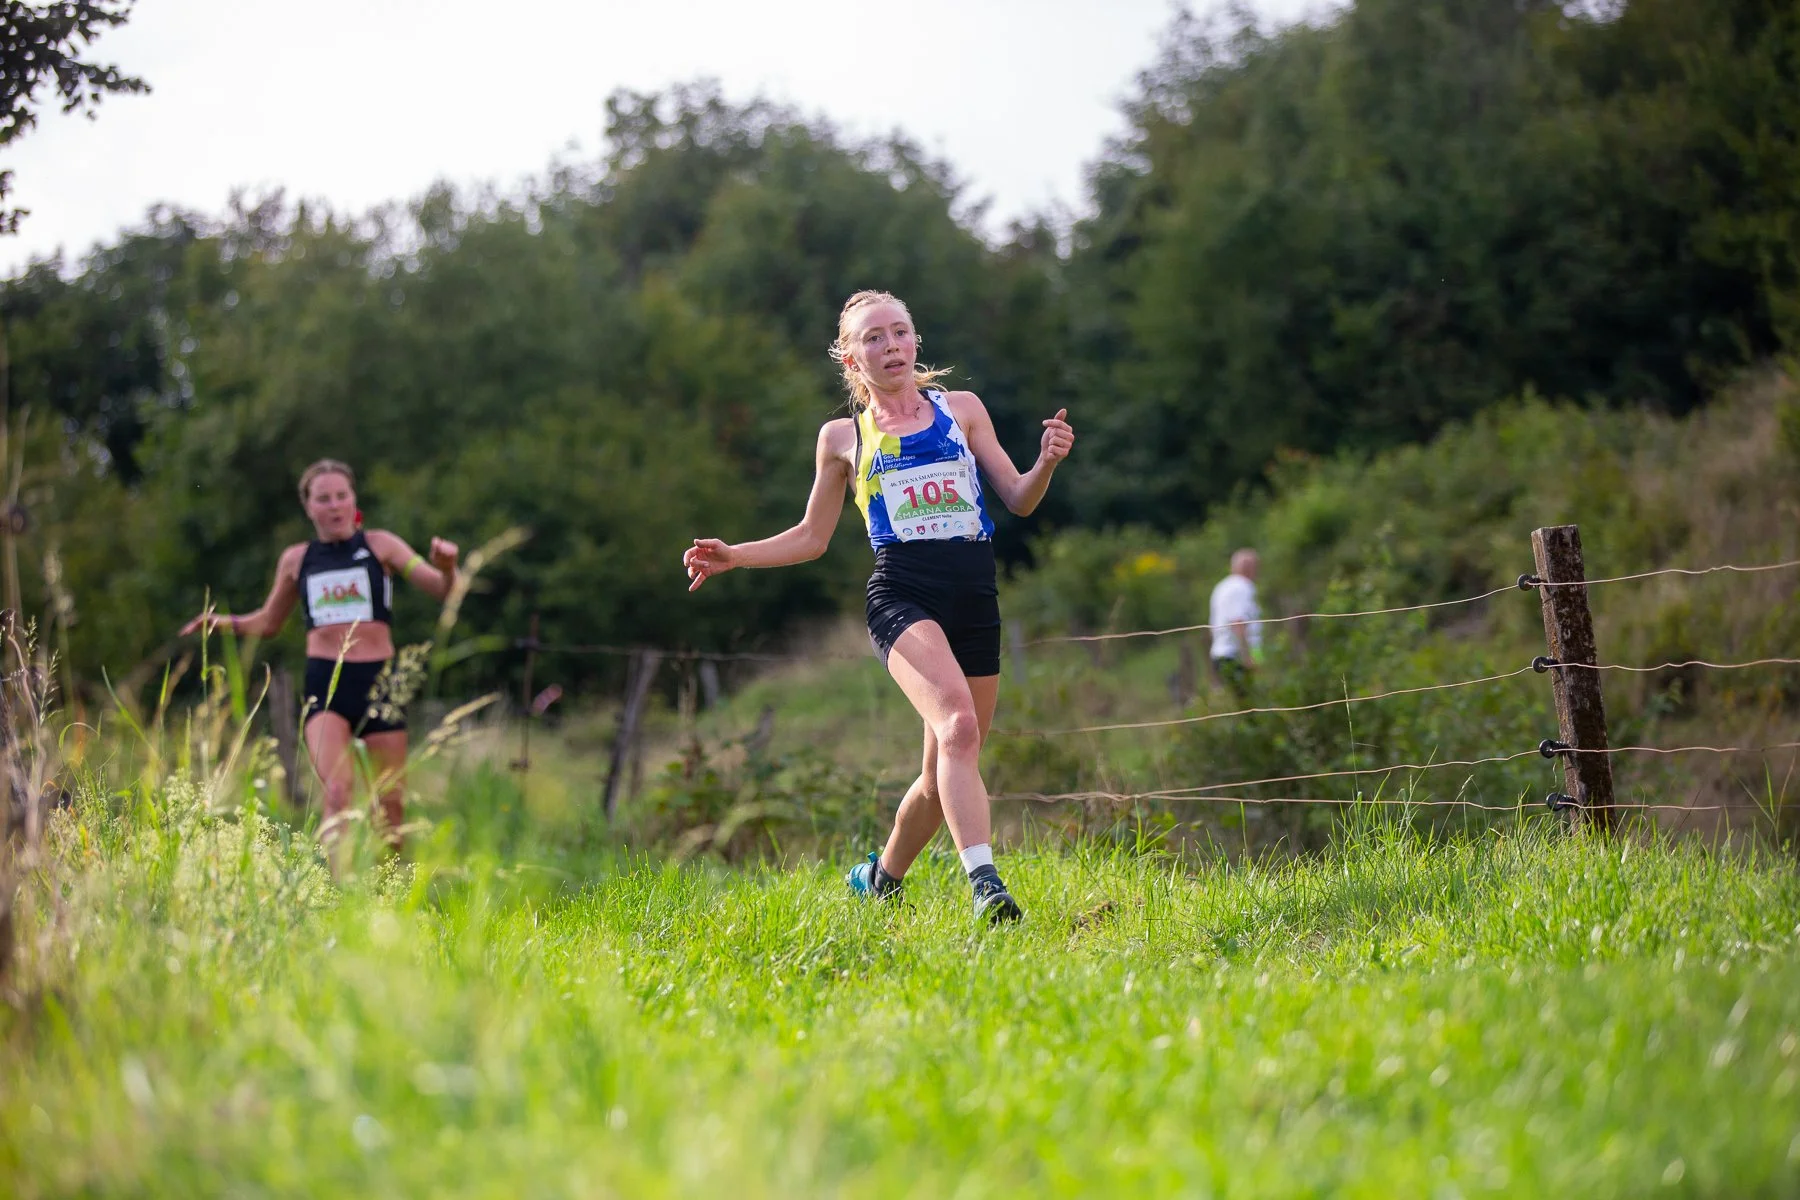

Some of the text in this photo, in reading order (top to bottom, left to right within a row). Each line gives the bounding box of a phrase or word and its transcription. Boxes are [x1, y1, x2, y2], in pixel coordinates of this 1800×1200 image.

[918, 472, 941, 481] ŠMARNO
[902, 479, 959, 509] 105
[896, 507, 942, 520] ŠMARNA
